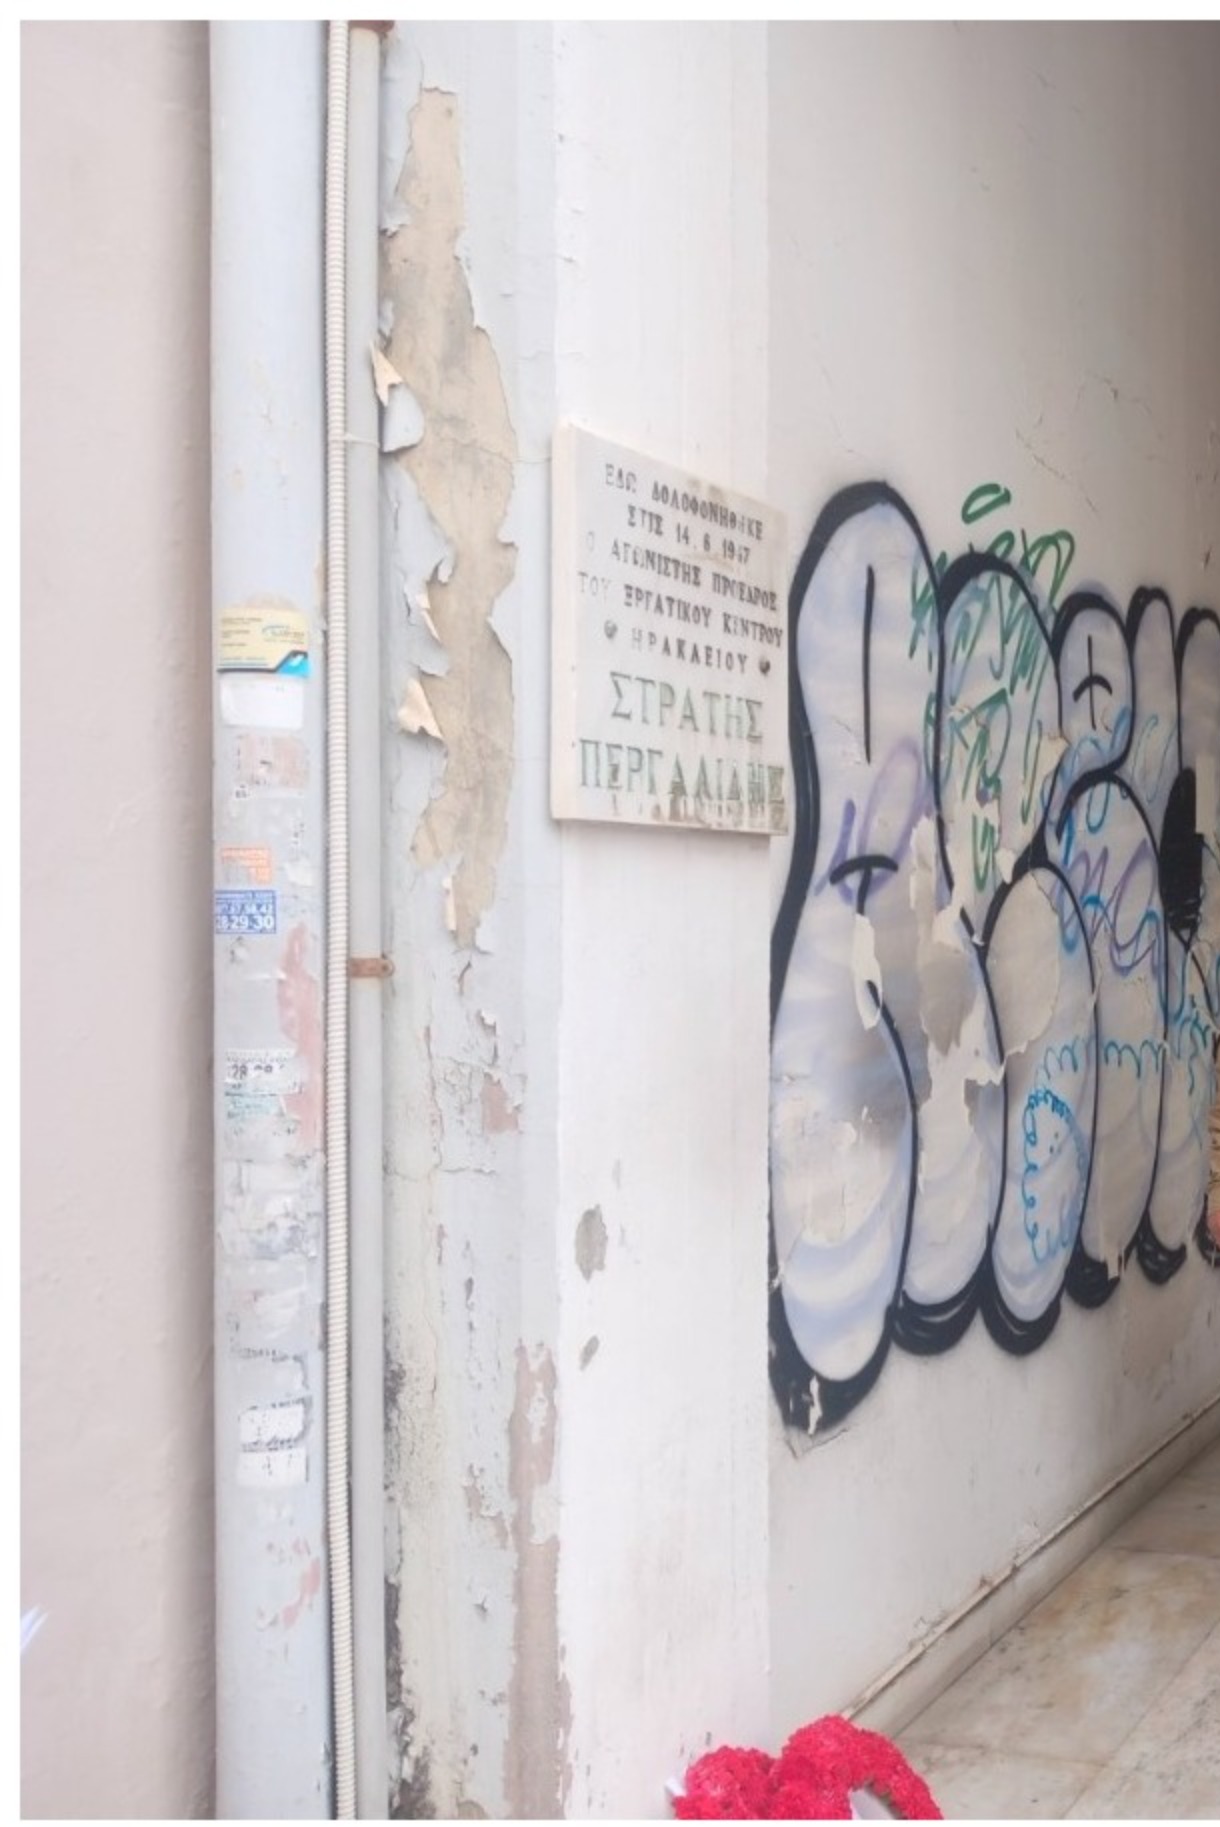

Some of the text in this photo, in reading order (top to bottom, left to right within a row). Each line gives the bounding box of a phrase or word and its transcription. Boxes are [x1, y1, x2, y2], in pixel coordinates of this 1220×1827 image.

[606, 464, 637, 492] ΕΔΩ
[624, 584, 712, 629] ΕΡΓΑΤΙΚΟΥ
[632, 628, 749, 674] ΗΡΑΚΛΕΙΟΥ
[610, 671, 763, 744] ΣΤΡΑΤΗΣ
